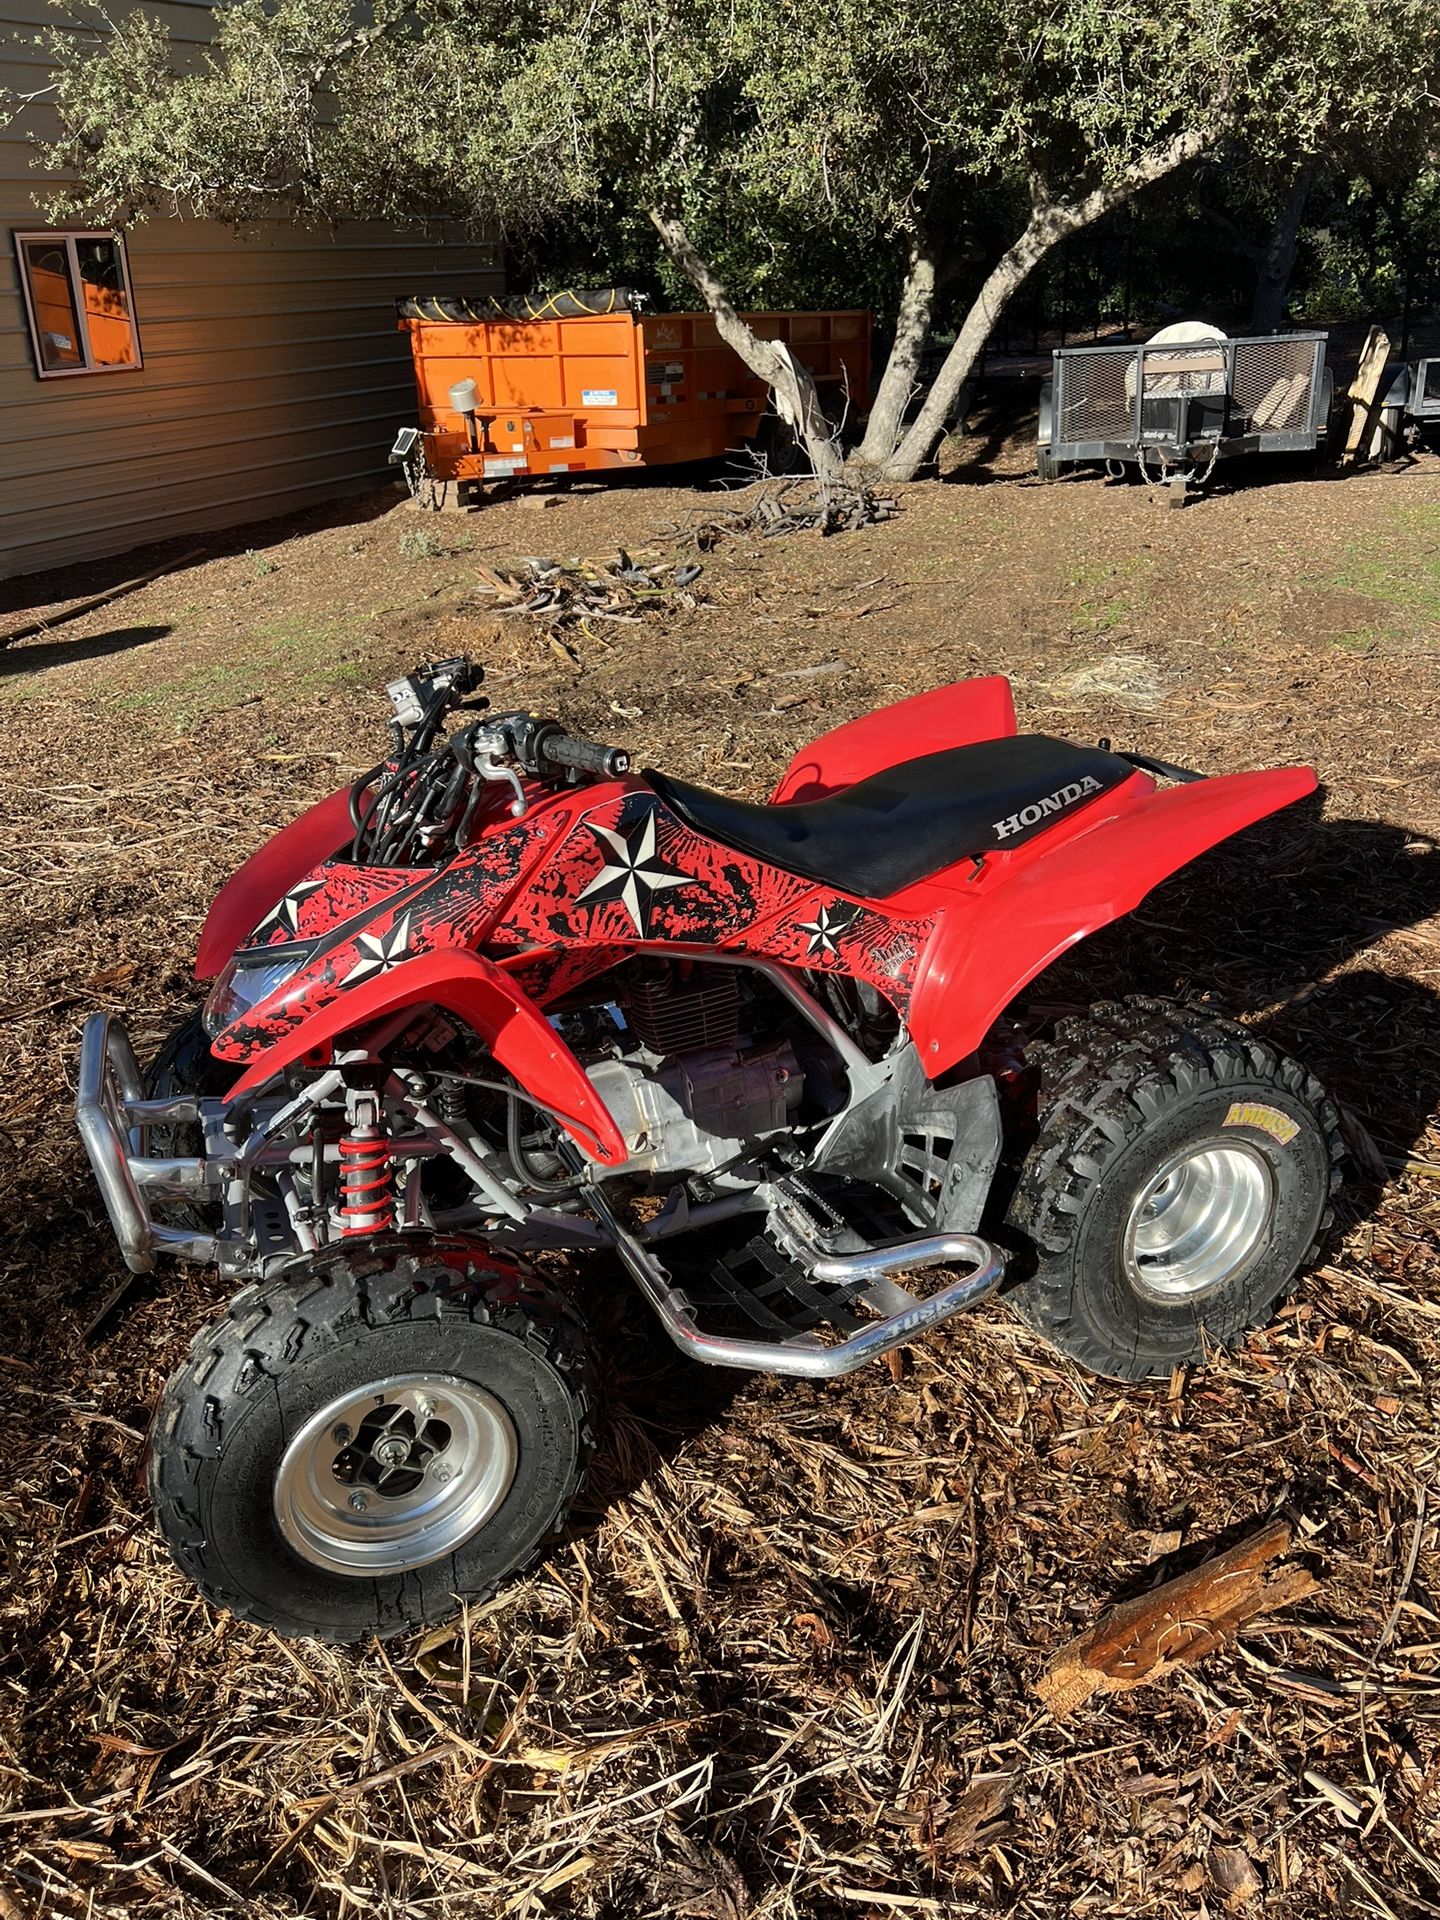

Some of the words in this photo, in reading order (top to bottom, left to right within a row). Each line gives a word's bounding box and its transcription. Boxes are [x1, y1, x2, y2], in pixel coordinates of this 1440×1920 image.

[992, 775, 1104, 840] HONDA
[1224, 1103, 1298, 1144] AMBUSH
[884, 1295, 954, 1335] TUSK
